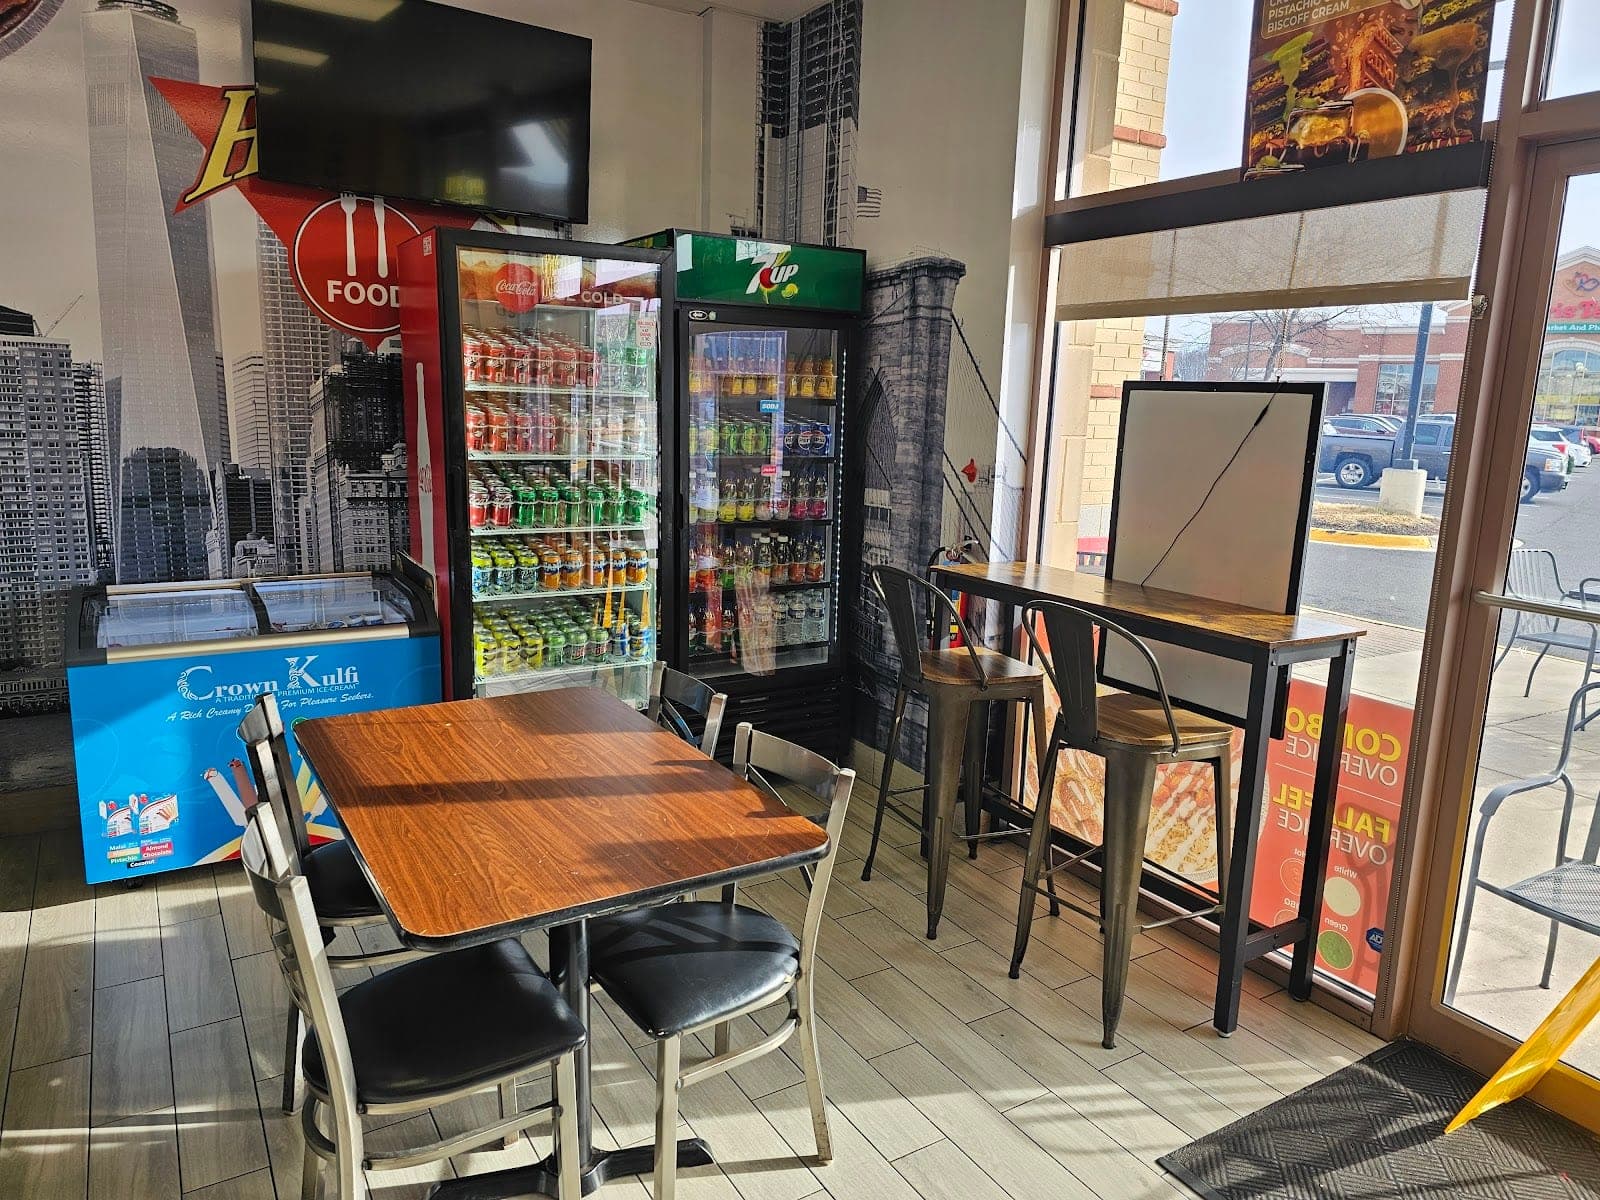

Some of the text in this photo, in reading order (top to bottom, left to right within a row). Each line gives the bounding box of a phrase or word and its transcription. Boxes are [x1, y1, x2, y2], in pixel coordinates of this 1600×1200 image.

[1267, 2, 1350, 33] BISCOFF CREAM
[1268, 0, 1321, 20] PISTACHIO
[745, 251, 799, 294] 7UP
[581, 291, 624, 305] COLD
[176, 655, 360, 701] Crown Kulfi
[224, 693, 255, 702] TRADITI
[277, 687, 315, 697] PREMIUM
[316, 684, 357, 694] ICE-CREAM
[166, 712, 177, 722] A
[180, 710, 203, 721] Rich
[206, 708, 241, 719] Creamy
[281, 699, 297, 710] For
[300, 696, 337, 707] Pleasure
